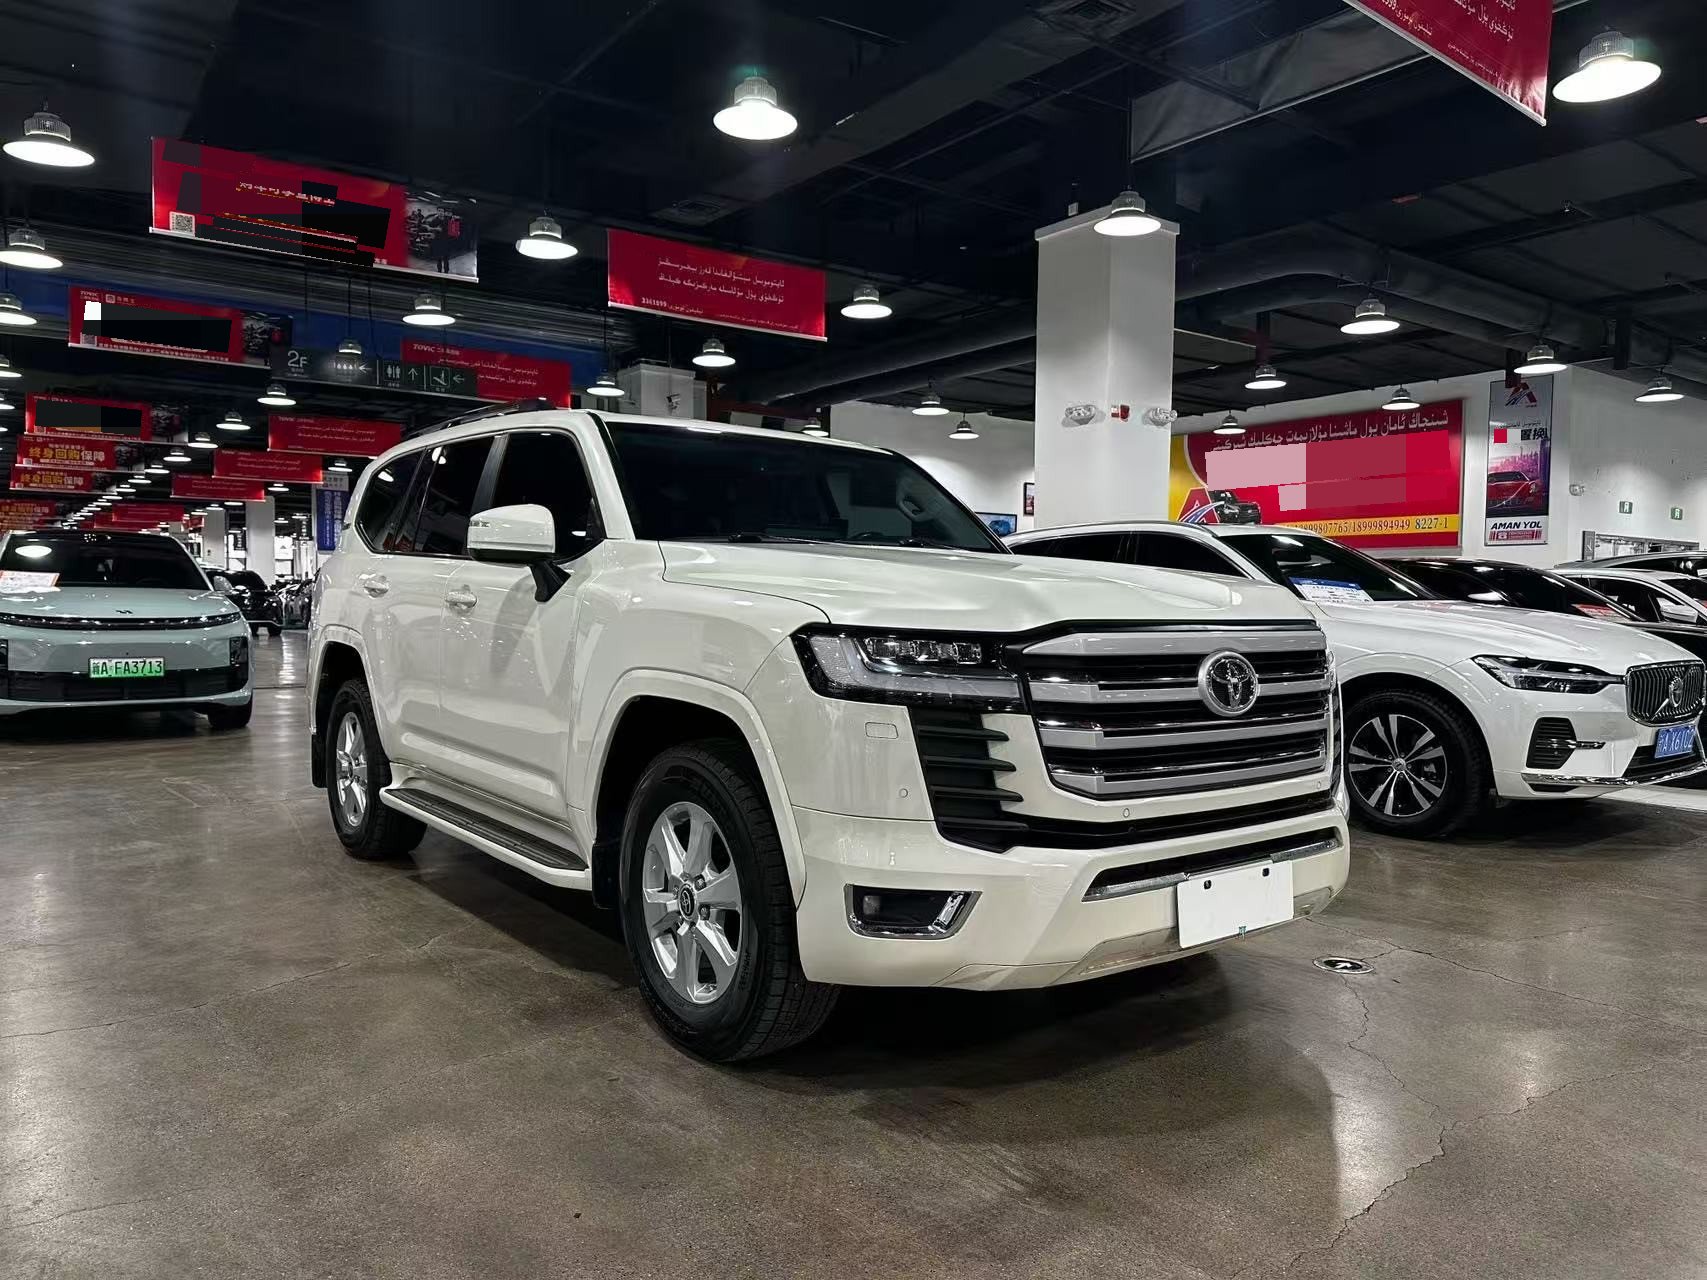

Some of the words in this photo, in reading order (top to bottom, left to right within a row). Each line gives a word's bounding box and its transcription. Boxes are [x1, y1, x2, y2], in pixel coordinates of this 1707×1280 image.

[287, 350, 308, 369] 2F
[1294, 519, 1411, 534] 99807765/18999894949
[1414, 517, 1449, 530] 8227-1
[1491, 522, 1521, 530] AMAN
[1523, 521, 1542, 529] YOL
[115, 660, 162, 674] FA3713
